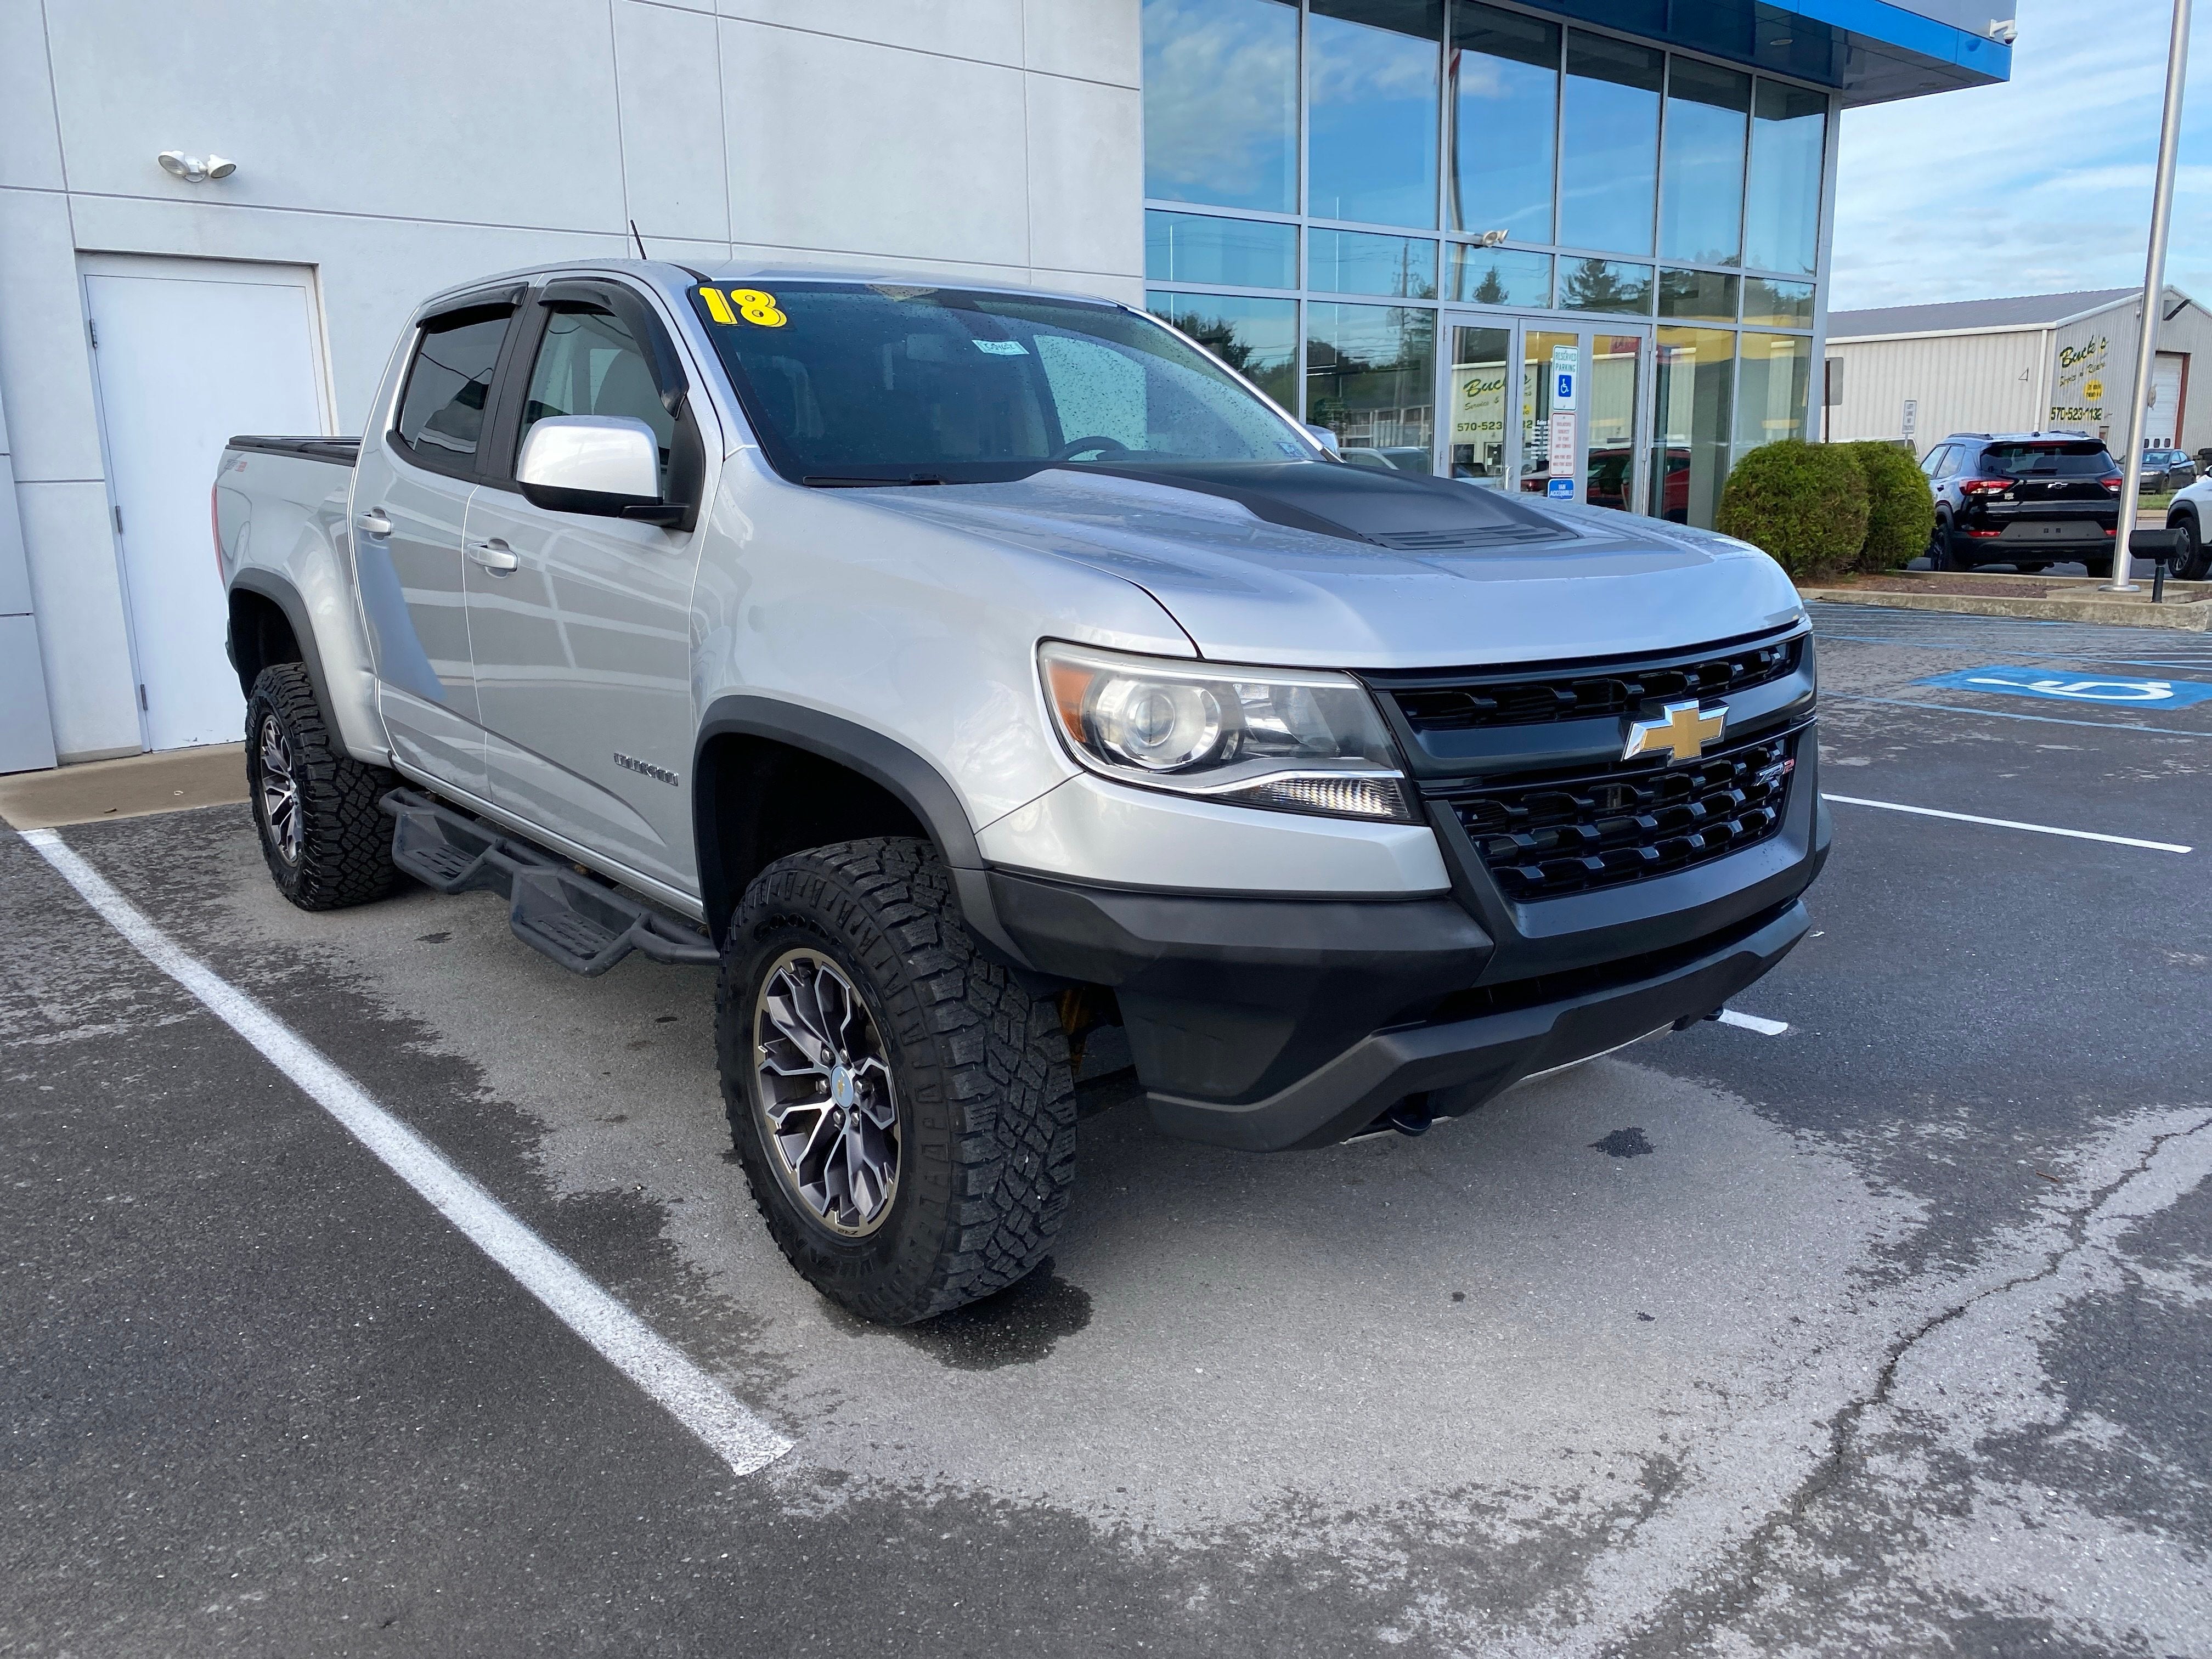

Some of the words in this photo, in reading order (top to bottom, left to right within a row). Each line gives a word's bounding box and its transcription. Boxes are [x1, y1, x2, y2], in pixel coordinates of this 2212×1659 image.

[699, 287, 788, 328] 18
[1555, 352, 1577, 362] RESERVED
[2059, 335, 2108, 368] Buck's
[1555, 363, 1576, 372] PARKING
[2051, 407, 2102, 421] 570-523-1132
[1752, 758, 1795, 787] ZR2
